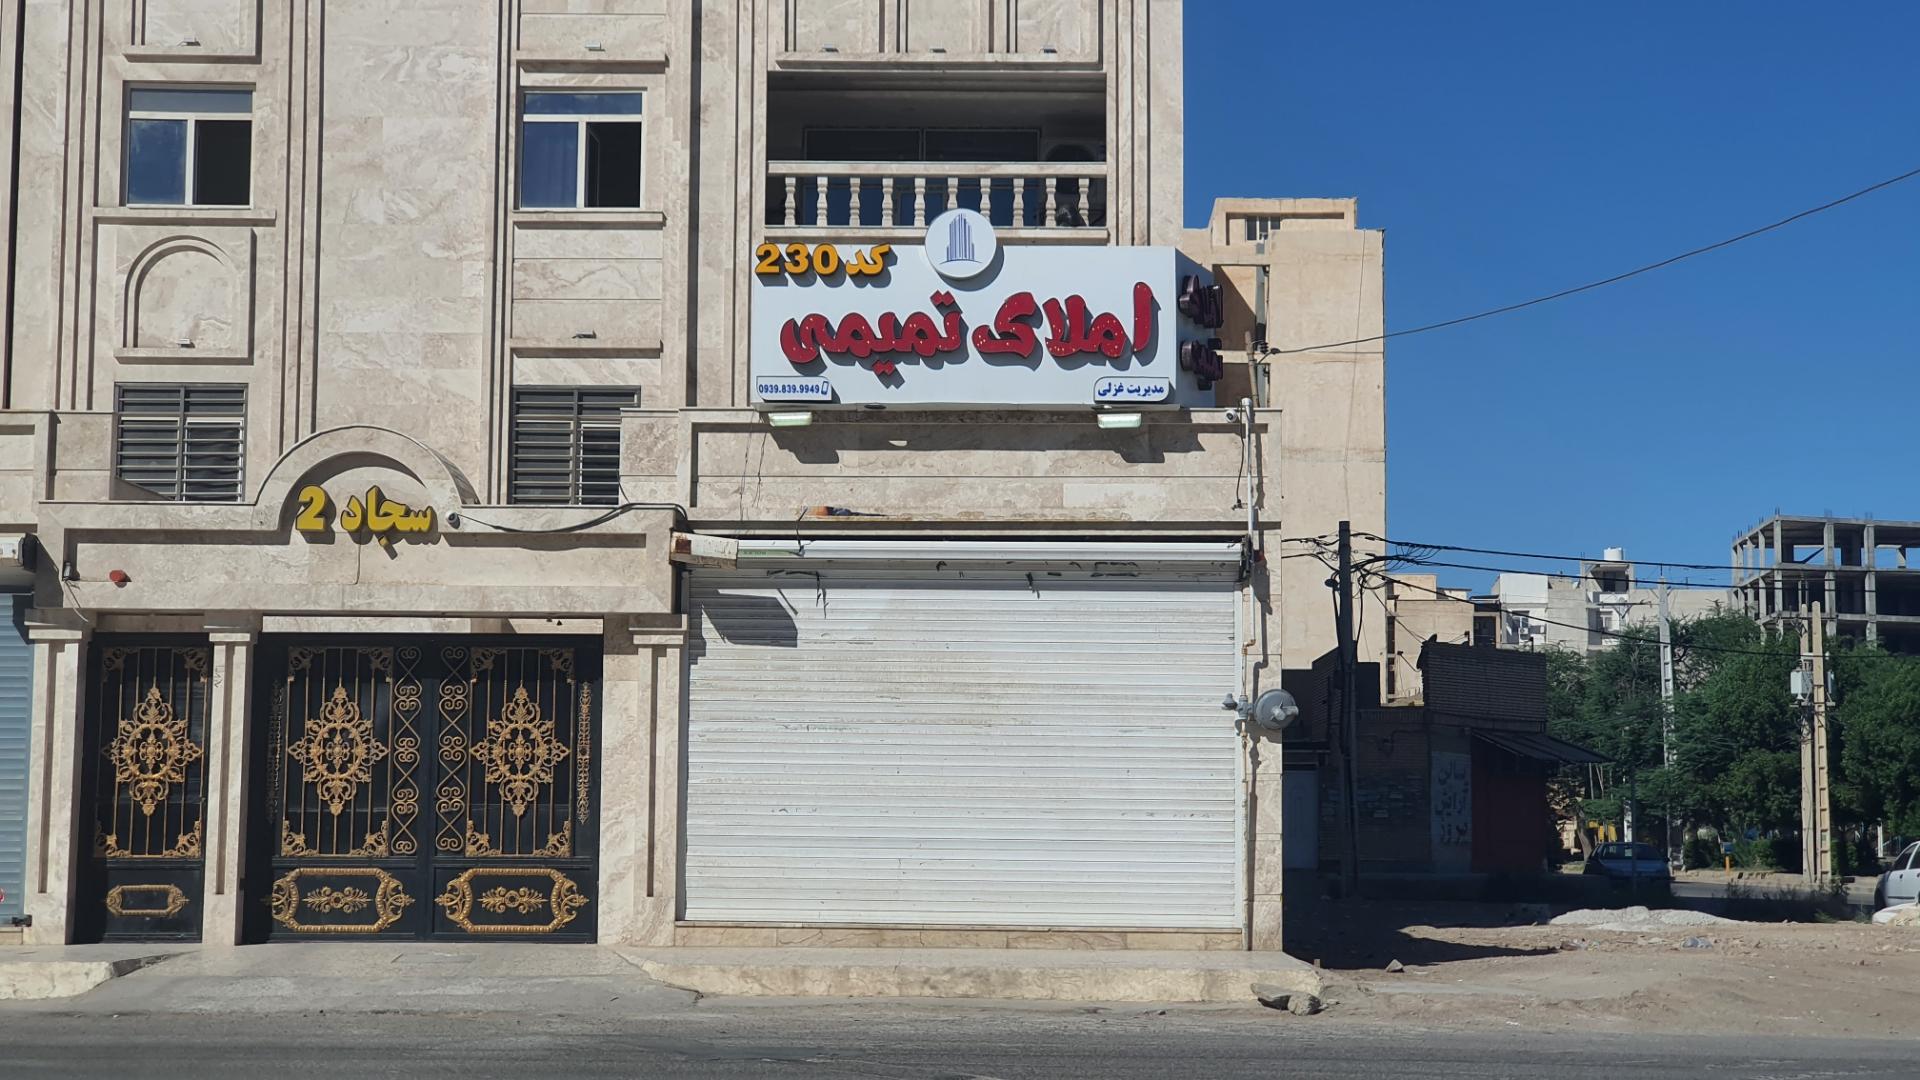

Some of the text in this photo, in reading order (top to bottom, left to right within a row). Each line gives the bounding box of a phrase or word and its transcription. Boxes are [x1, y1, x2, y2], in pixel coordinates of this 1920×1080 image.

[755, 242, 891, 275] کد 230
[780, 281, 1154, 375] املاک تمیمی
[758, 383, 820, 394] 0939.839.9949
[1098, 382, 1164, 396] مدیریت غزلی
[295, 485, 433, 547] سجاد 2
